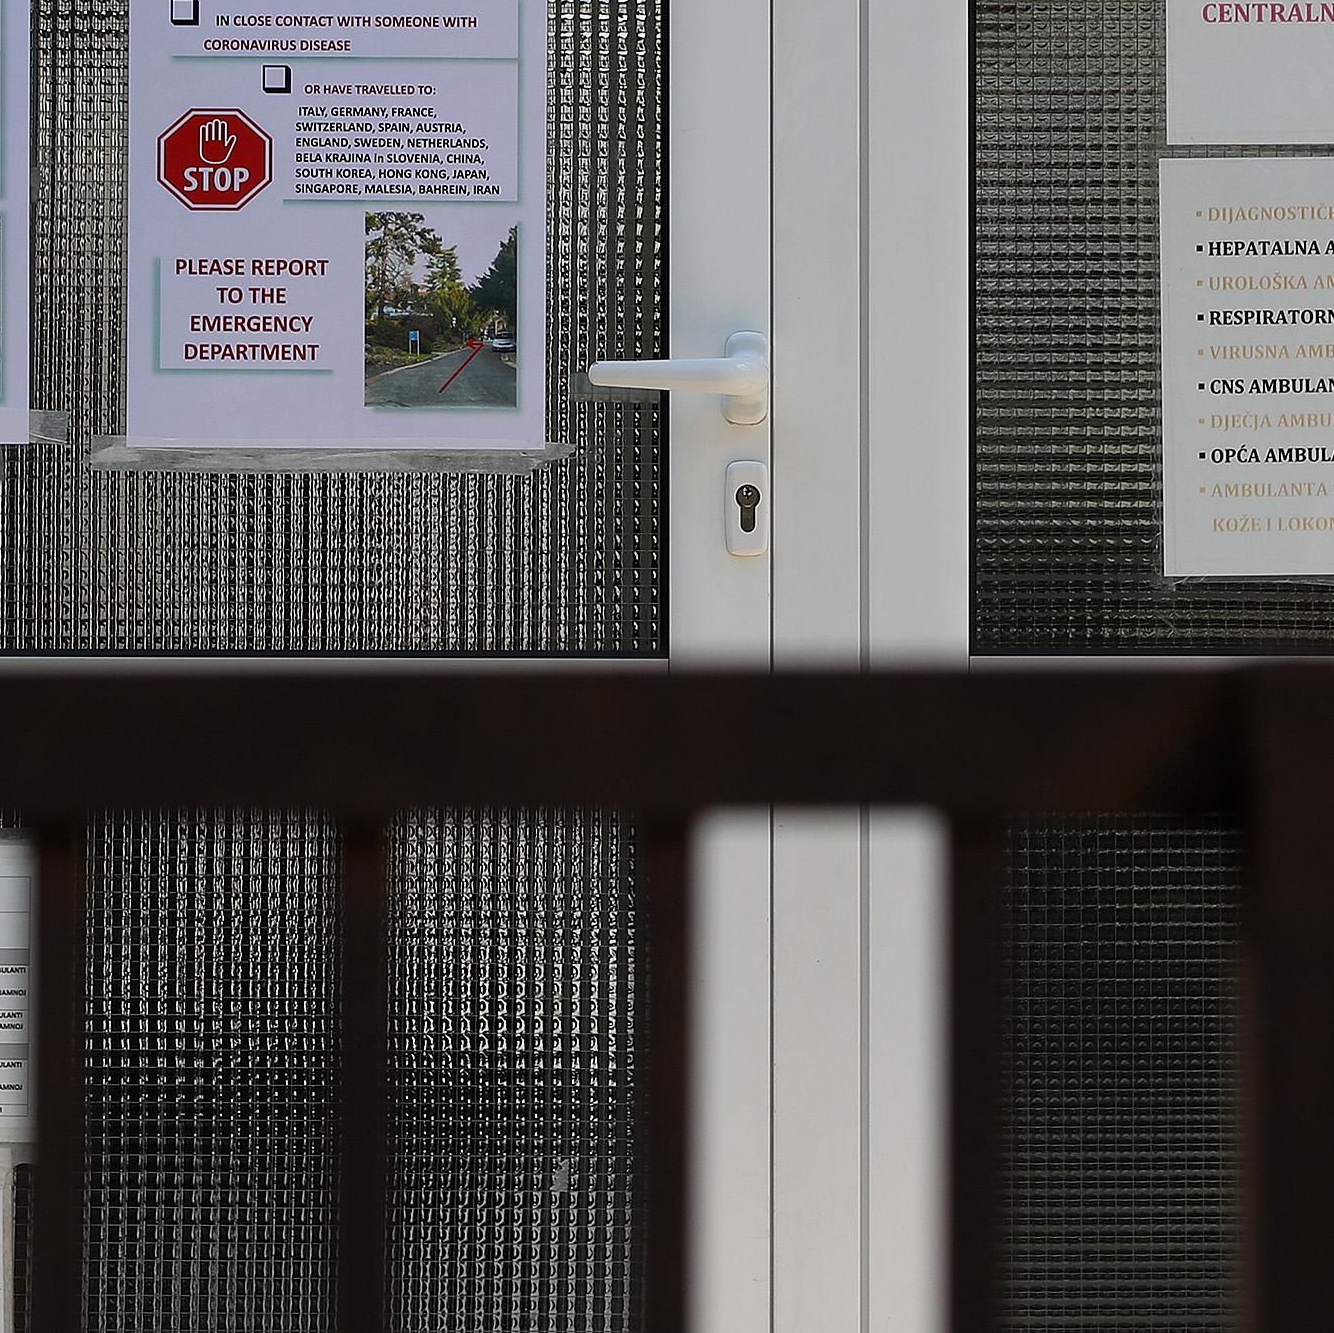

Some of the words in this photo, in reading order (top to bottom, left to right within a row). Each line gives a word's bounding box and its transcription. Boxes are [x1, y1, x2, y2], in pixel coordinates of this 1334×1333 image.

[216, 15, 230, 27] IN
[233, 15, 272, 27] CLOSE
[275, 15, 334, 27] CONTACT
[336, 15, 371, 28] WITH
[374, 16, 440, 28] SOMEONE
[442, 16, 477, 28] WITH
[203, 39, 297, 51] CORONAVIRUS
[300, 39, 351, 52] DISEASE
[304, 84, 321, 95] OR
[323, 84, 353, 95] HAVE
[354, 84, 416, 95] TRAVELLED
[417, 85, 437, 96] TO:
[183, 166, 250, 193] STOP
[295, 183, 362, 196] SINGAPORE,
[364, 184, 416, 196] MALESIA,
[418, 184, 471, 197] BAHREIN,
[473, 184, 500, 195] IRAN
[1208, 240, 1321, 257] HEPATALNA
[175, 258, 245, 276] PLEASE
[251, 259, 330, 276] REPORT
[1209, 272, 1308, 291] UROLOŠKA
[215, 287, 244, 304] TO
[248, 287, 287, 304] THE
[190, 315, 314, 333] EMERGENCY
[184, 343, 320, 361] DEPARTMENT
[1209, 344, 1290, 360] VIRUSNA
[1210, 378, 1245, 395] CNS
[1211, 414, 1272, 432] DJEČJA
[1210, 444, 1261, 464] OPĆA
[1211, 481, 1328, 498] AMBULANTA
[1212, 514, 1261, 533] KOŽE
[1266, 516, 1273, 531] I
